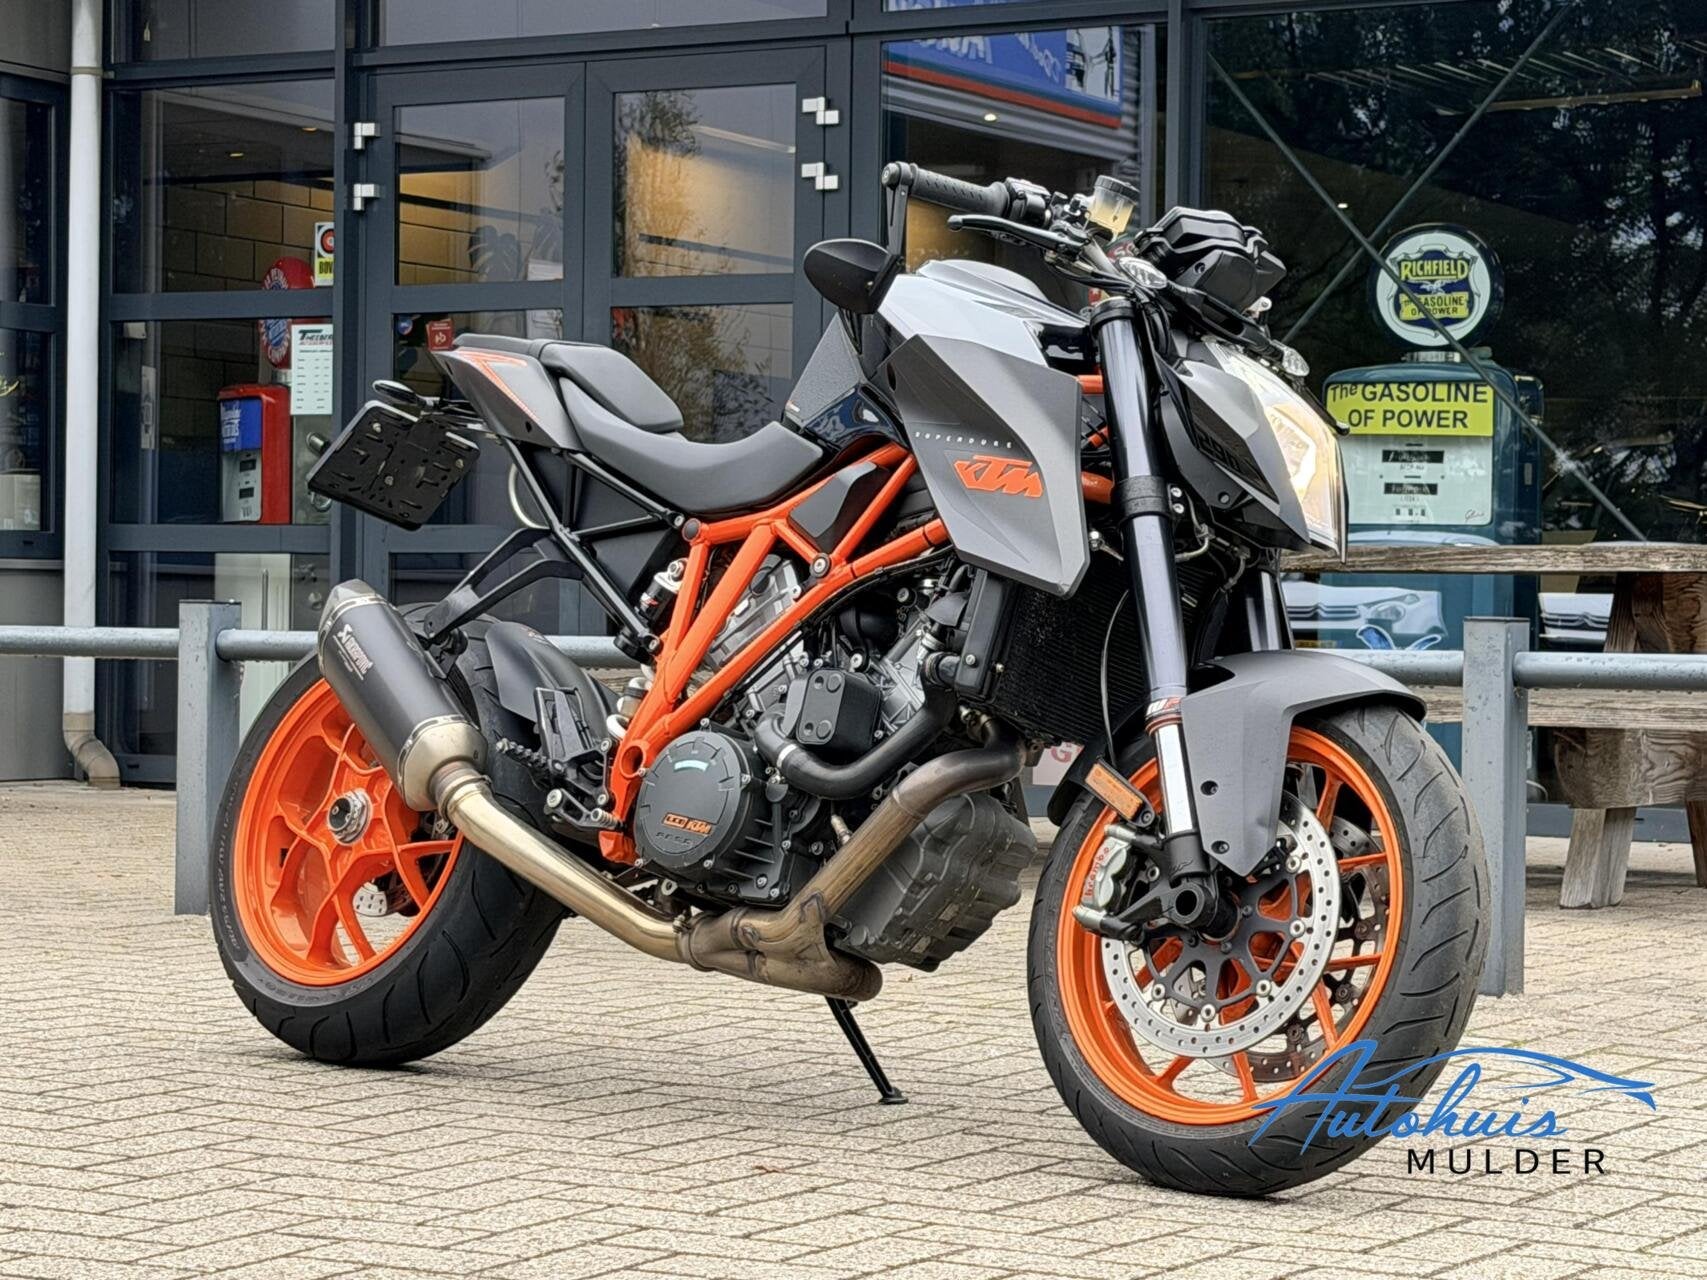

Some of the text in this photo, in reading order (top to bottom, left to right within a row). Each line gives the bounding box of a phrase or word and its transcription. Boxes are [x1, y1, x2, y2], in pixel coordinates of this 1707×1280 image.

[1400, 260, 1470, 281] RICHFIELD
[1417, 296, 1465, 308] ASOLINE
[1331, 382, 1488, 403] The GASOLINE
[1348, 409, 1468, 429] OF POWER
[953, 454, 1044, 498] KTM
[1085, 847, 1110, 897] brembo
